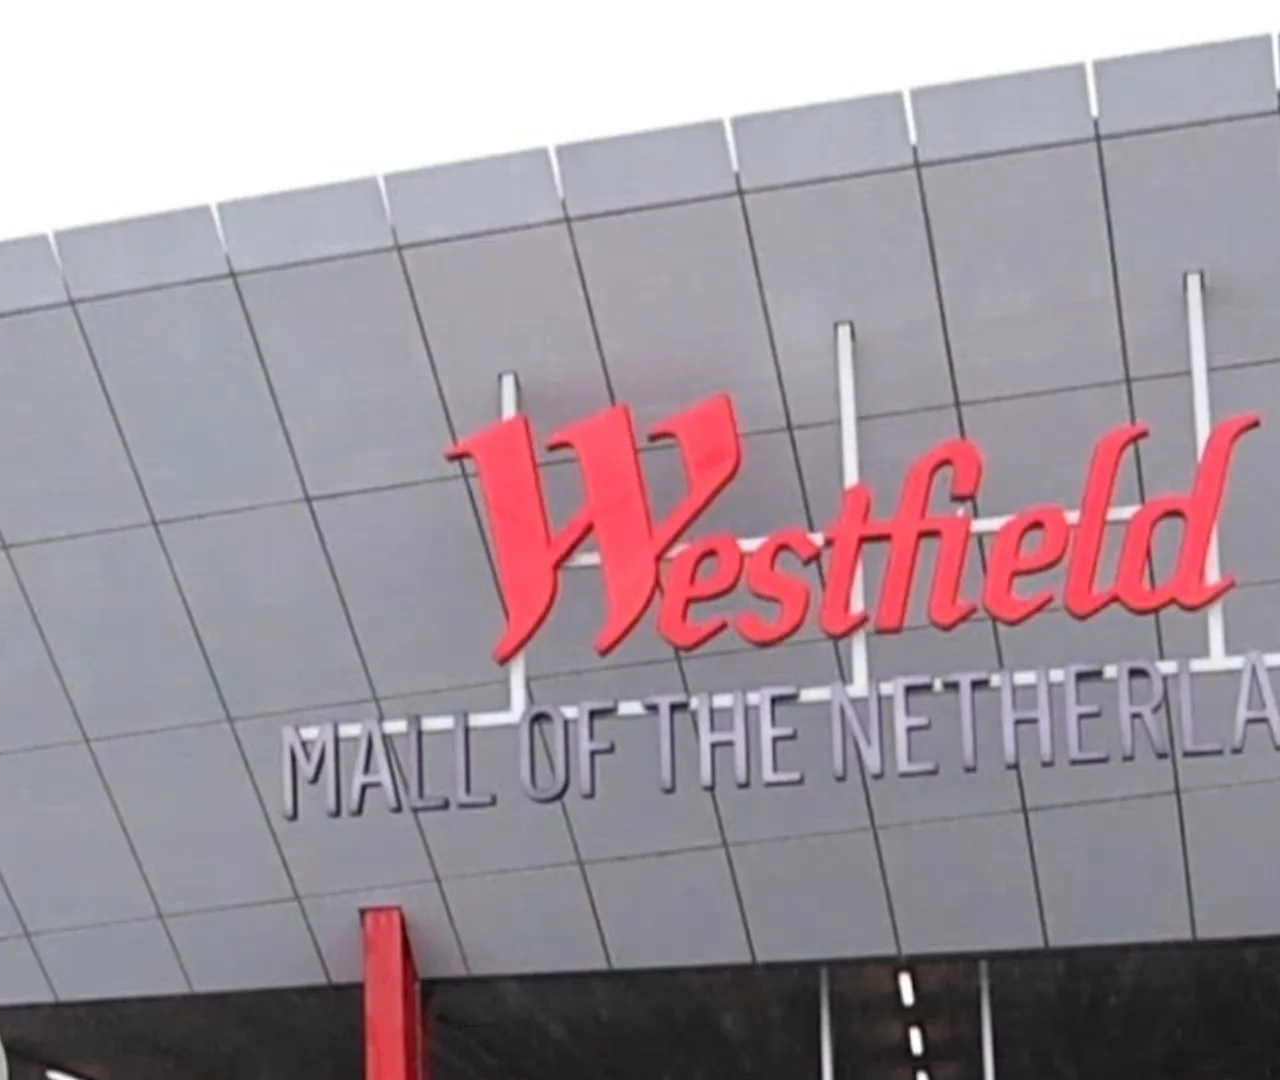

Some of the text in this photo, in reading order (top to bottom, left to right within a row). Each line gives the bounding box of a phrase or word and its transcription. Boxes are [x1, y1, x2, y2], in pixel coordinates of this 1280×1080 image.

[445, 391, 1261, 664] Westfield
[281, 719, 496, 821] MALL
[517, 700, 618, 806] OF
[642, 686, 805, 794] THE
